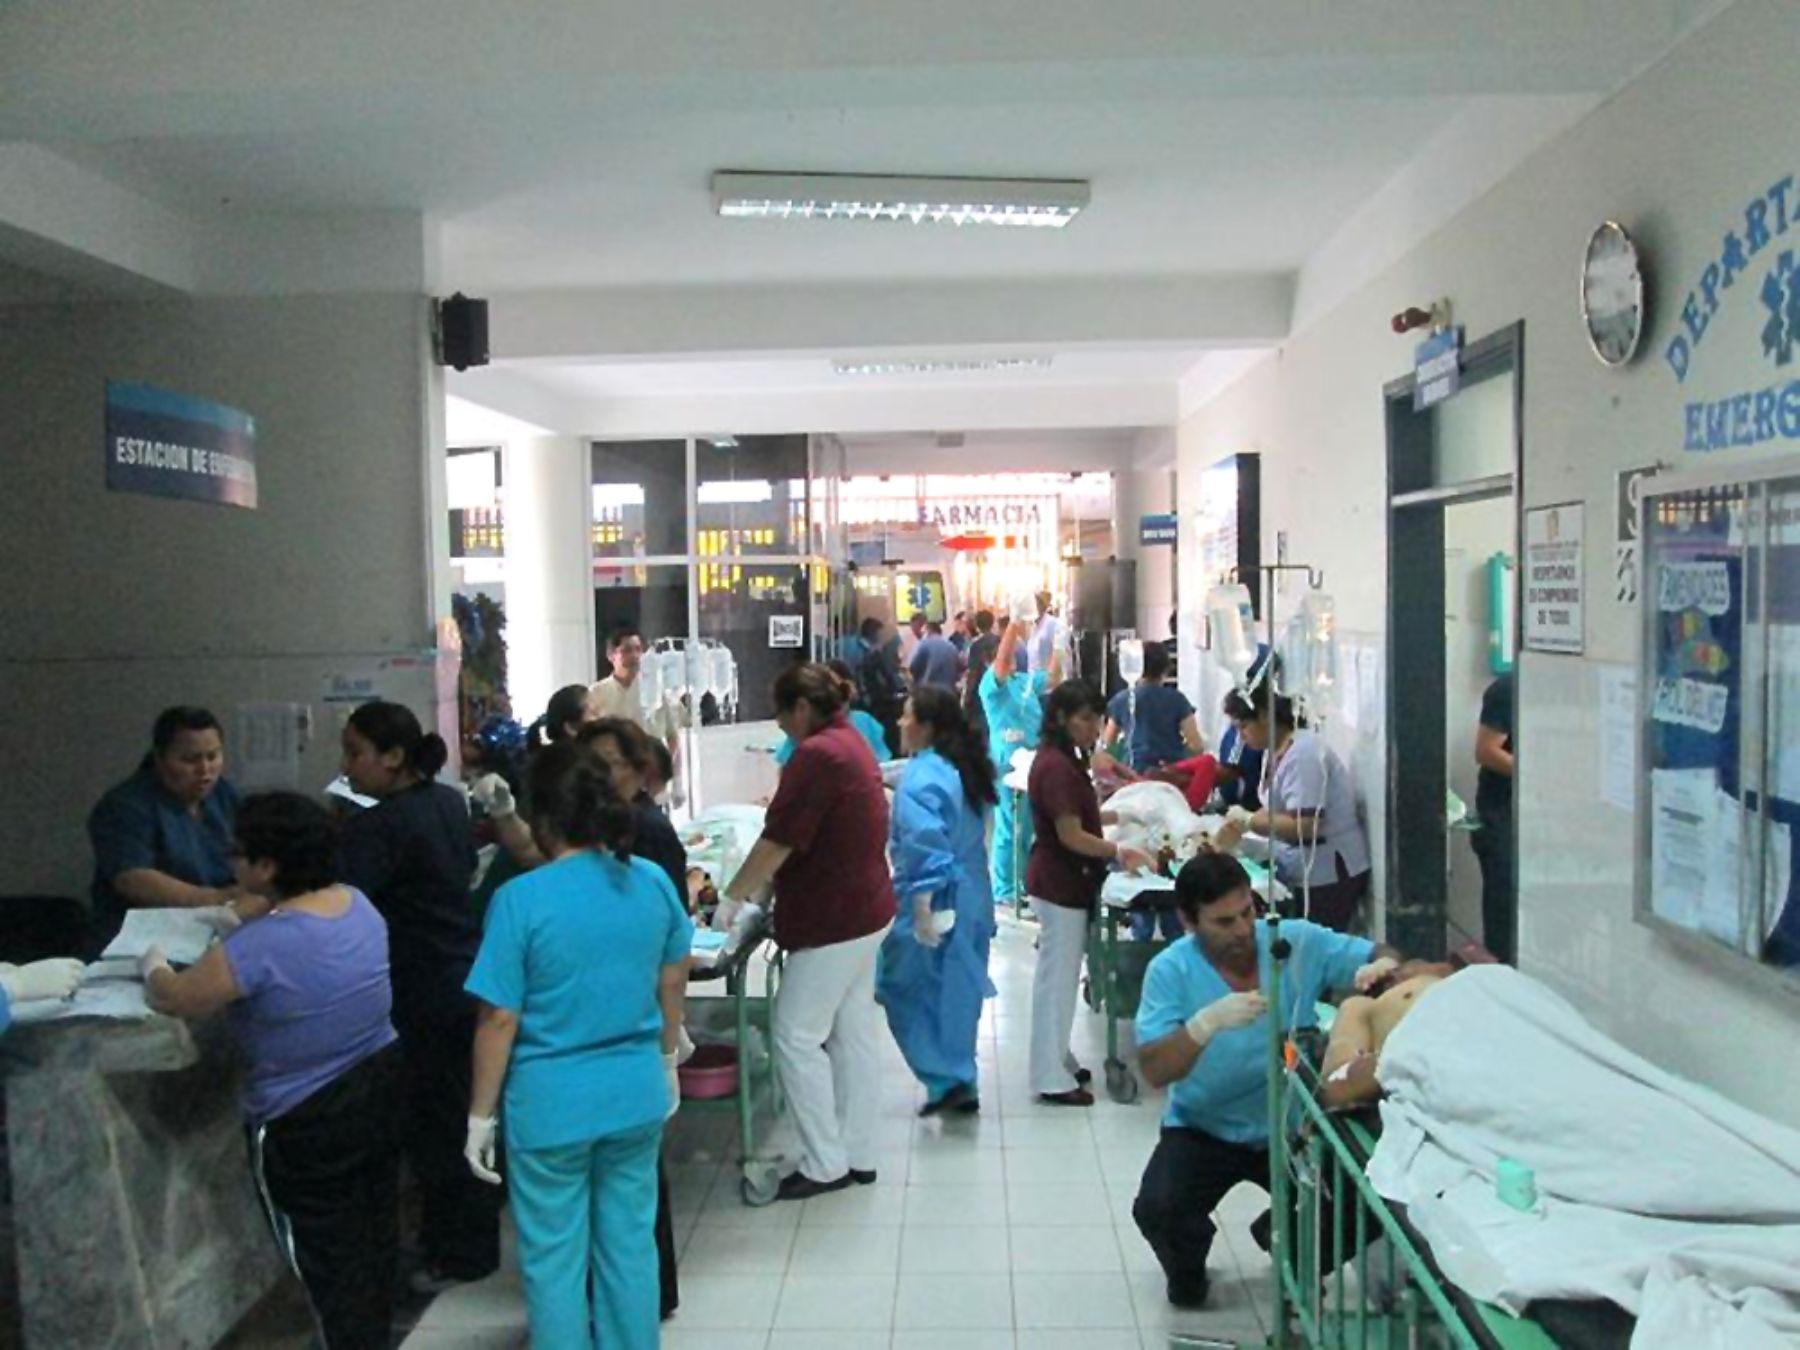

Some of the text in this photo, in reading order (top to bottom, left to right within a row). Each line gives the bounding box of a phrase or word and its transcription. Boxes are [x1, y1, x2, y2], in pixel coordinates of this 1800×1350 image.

[115, 436, 189, 471] ESTACION
[191, 448, 208, 474] DE
[917, 503, 1041, 527] FARMACIA
